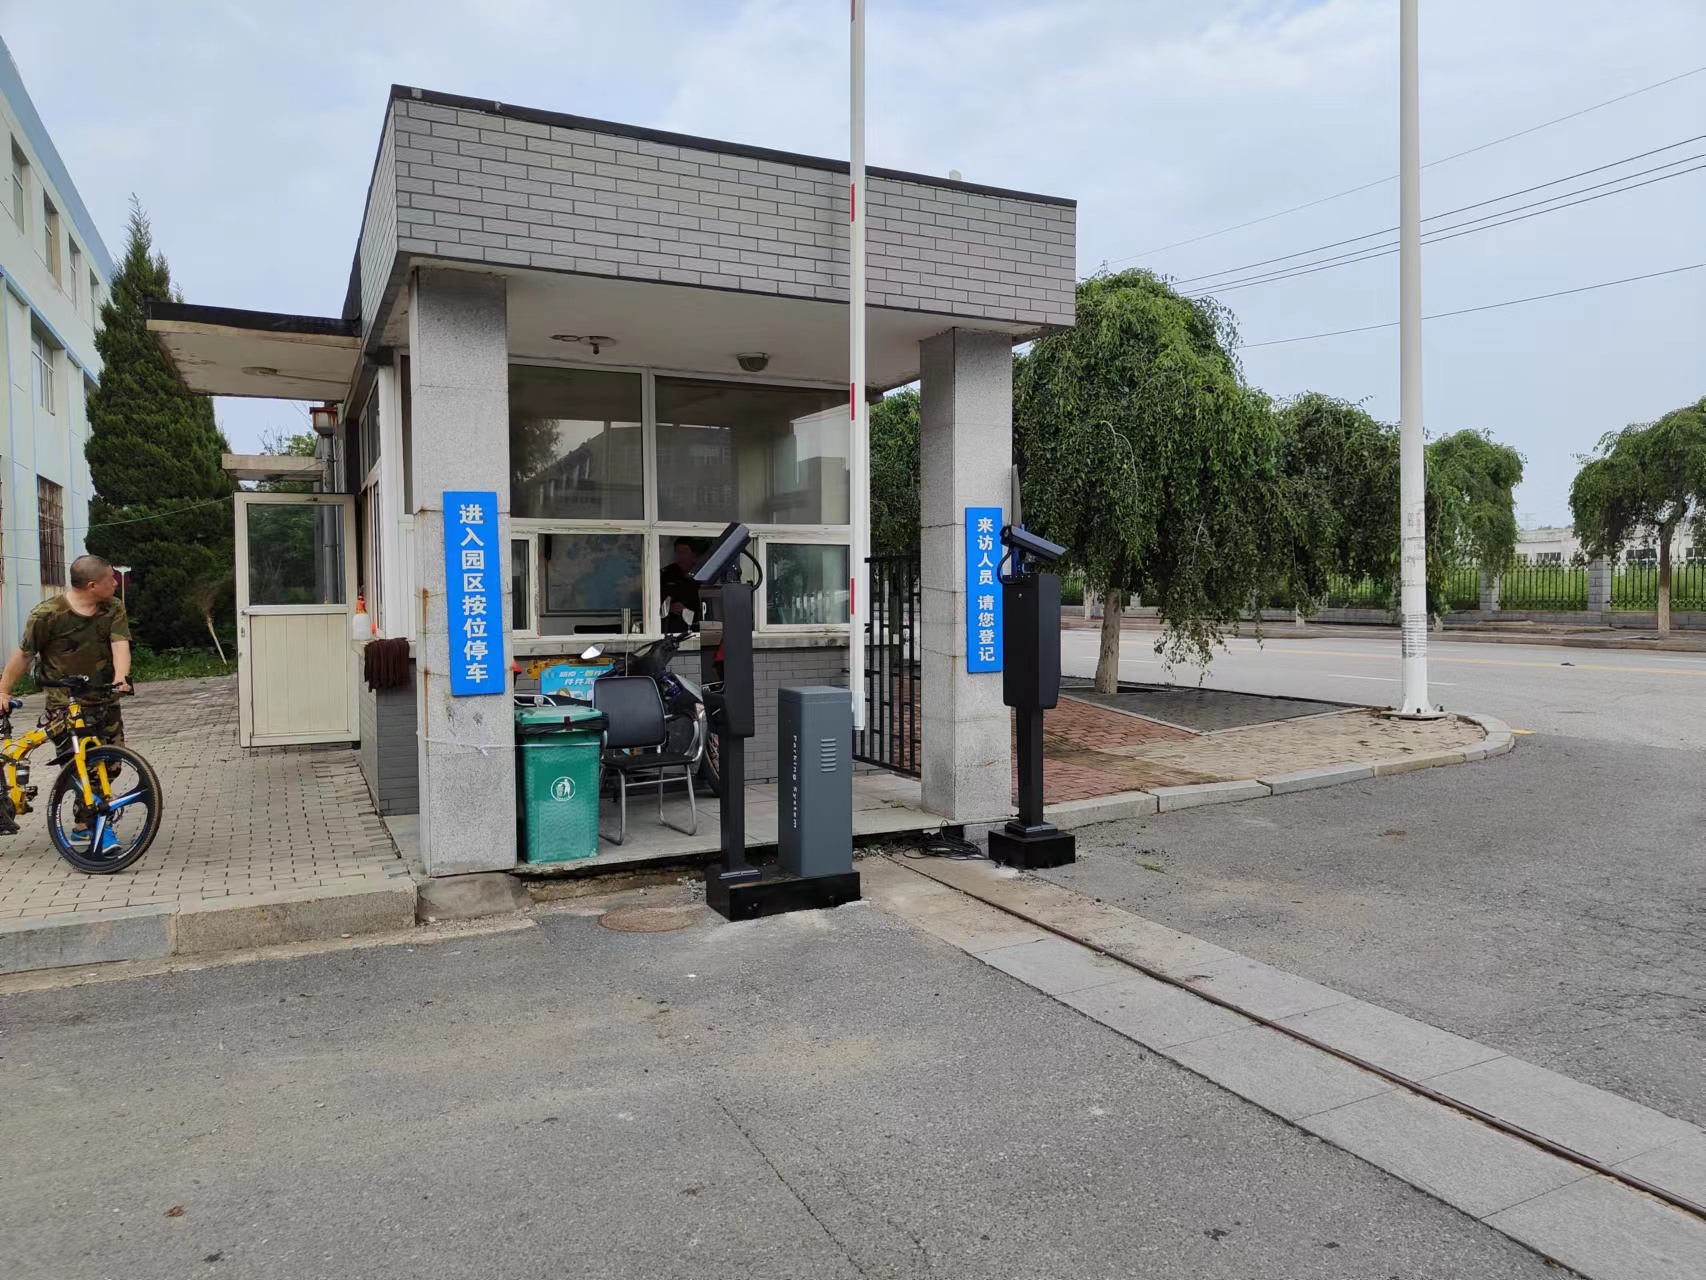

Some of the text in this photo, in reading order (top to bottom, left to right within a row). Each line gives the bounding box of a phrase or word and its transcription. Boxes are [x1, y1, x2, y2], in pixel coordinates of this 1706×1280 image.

[459, 503, 489, 684] 进入园区按位停车
[977, 517, 996, 662] 来访人员 请您登记
